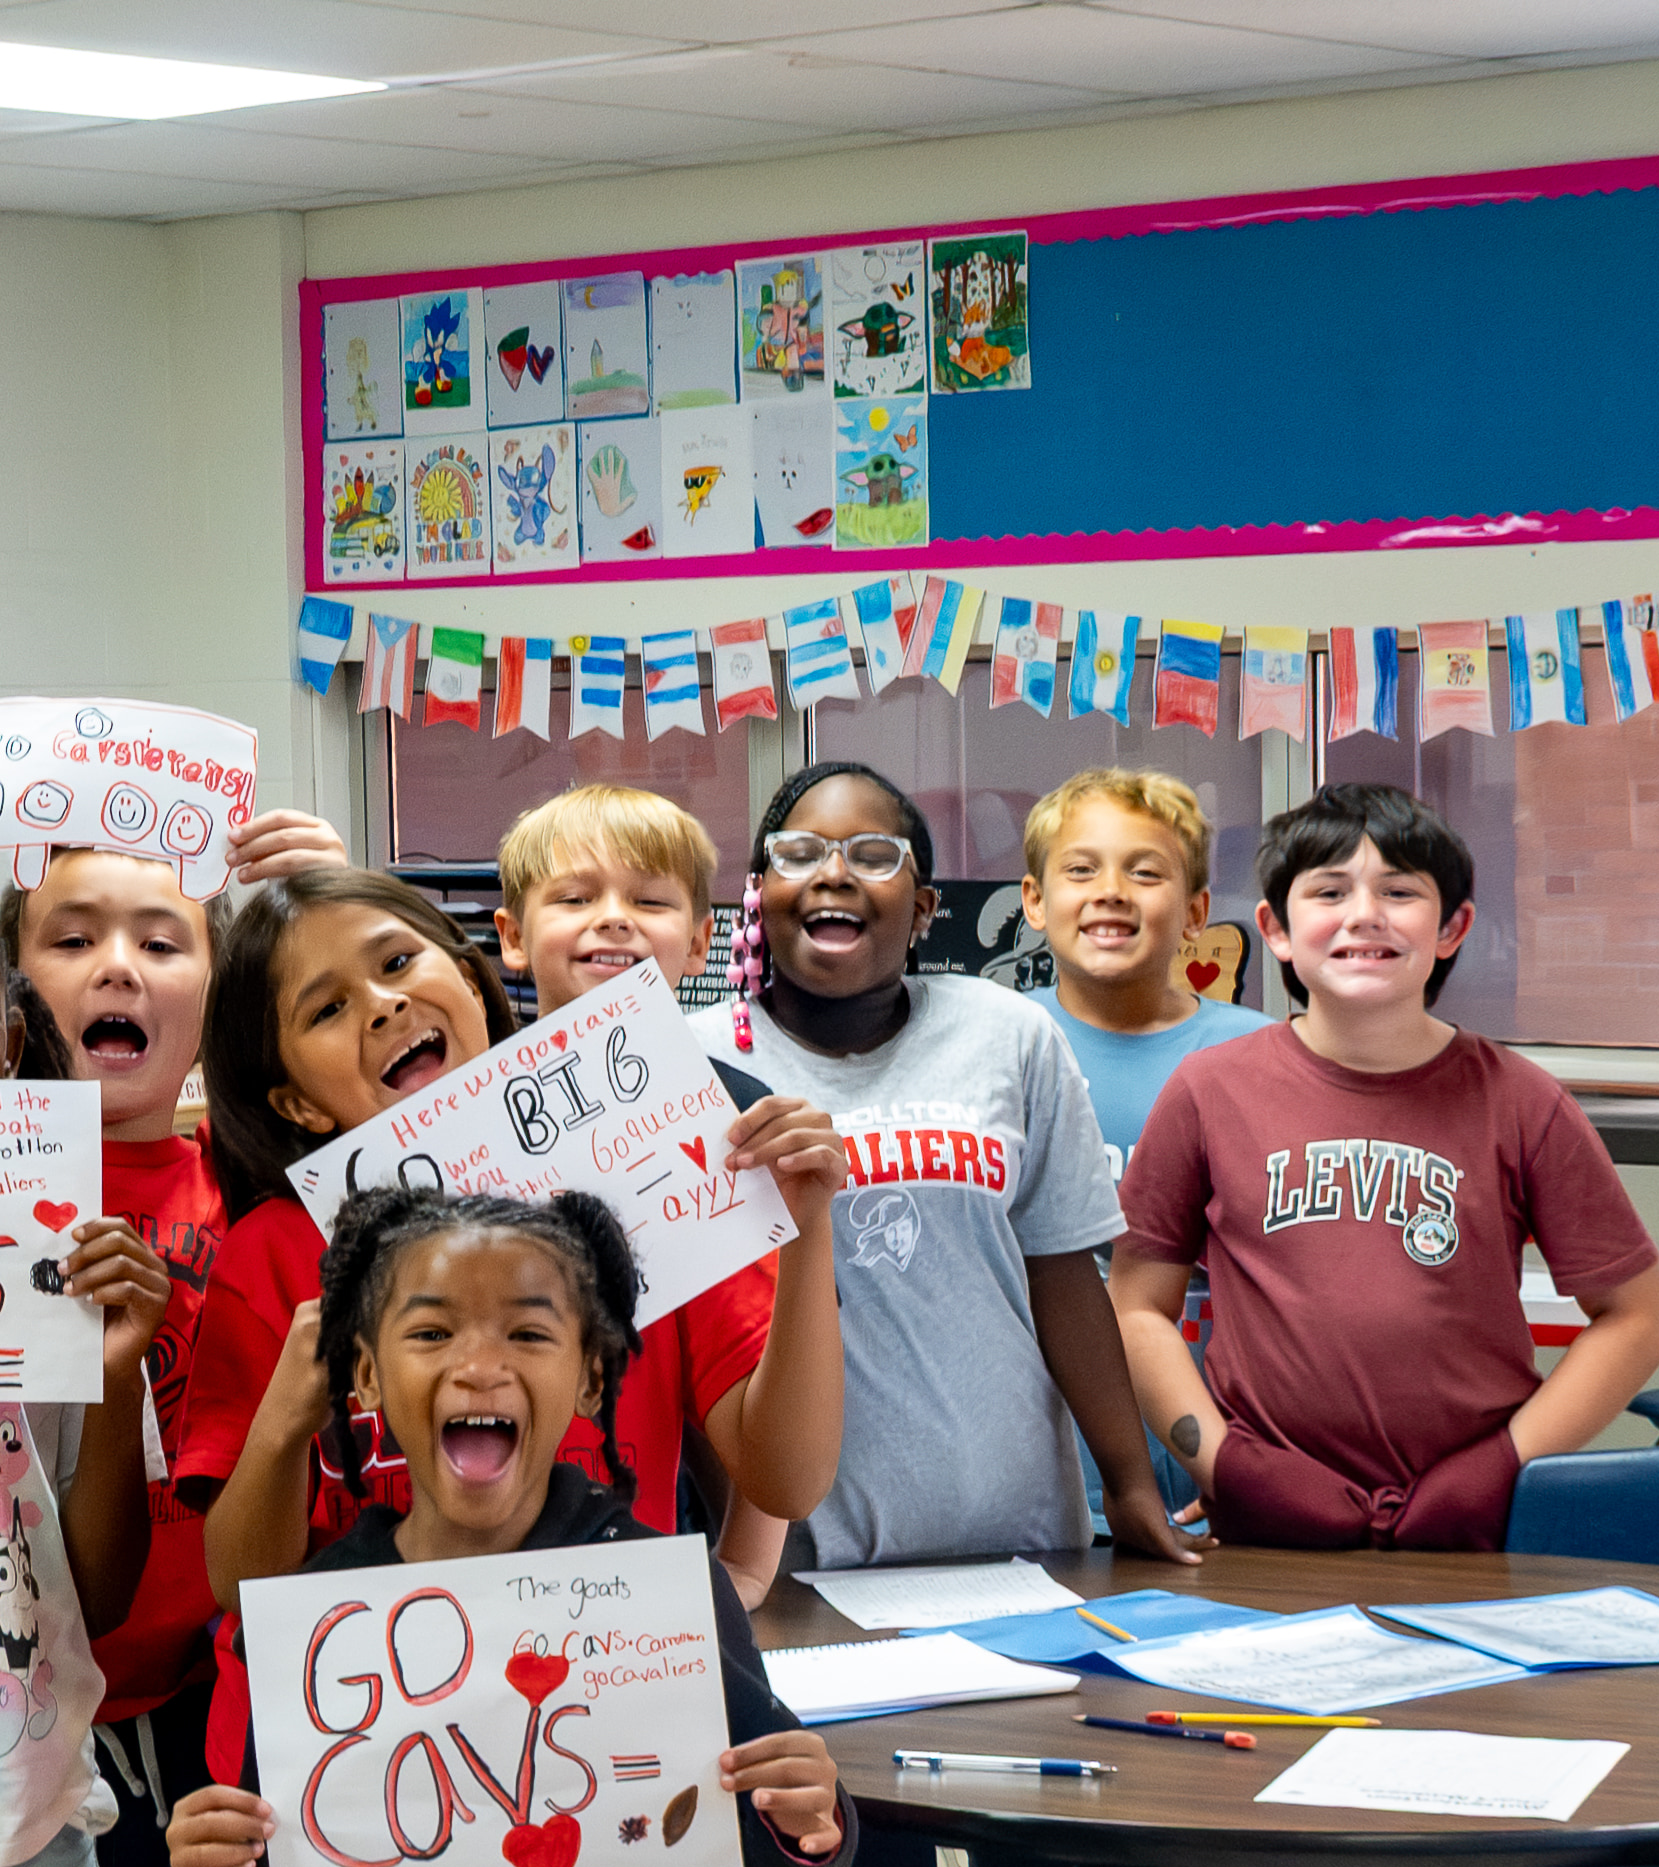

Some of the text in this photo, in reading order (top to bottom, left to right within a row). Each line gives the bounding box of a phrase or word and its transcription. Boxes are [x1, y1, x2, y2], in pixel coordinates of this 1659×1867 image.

[14, 1088, 52, 1112] the
[390, 1093, 460, 1148] Here
[464, 1057, 513, 1098] we
[516, 1044, 549, 1071] go
[506, 1574, 632, 1620] The goats
[302, 1585, 475, 1736] GO
